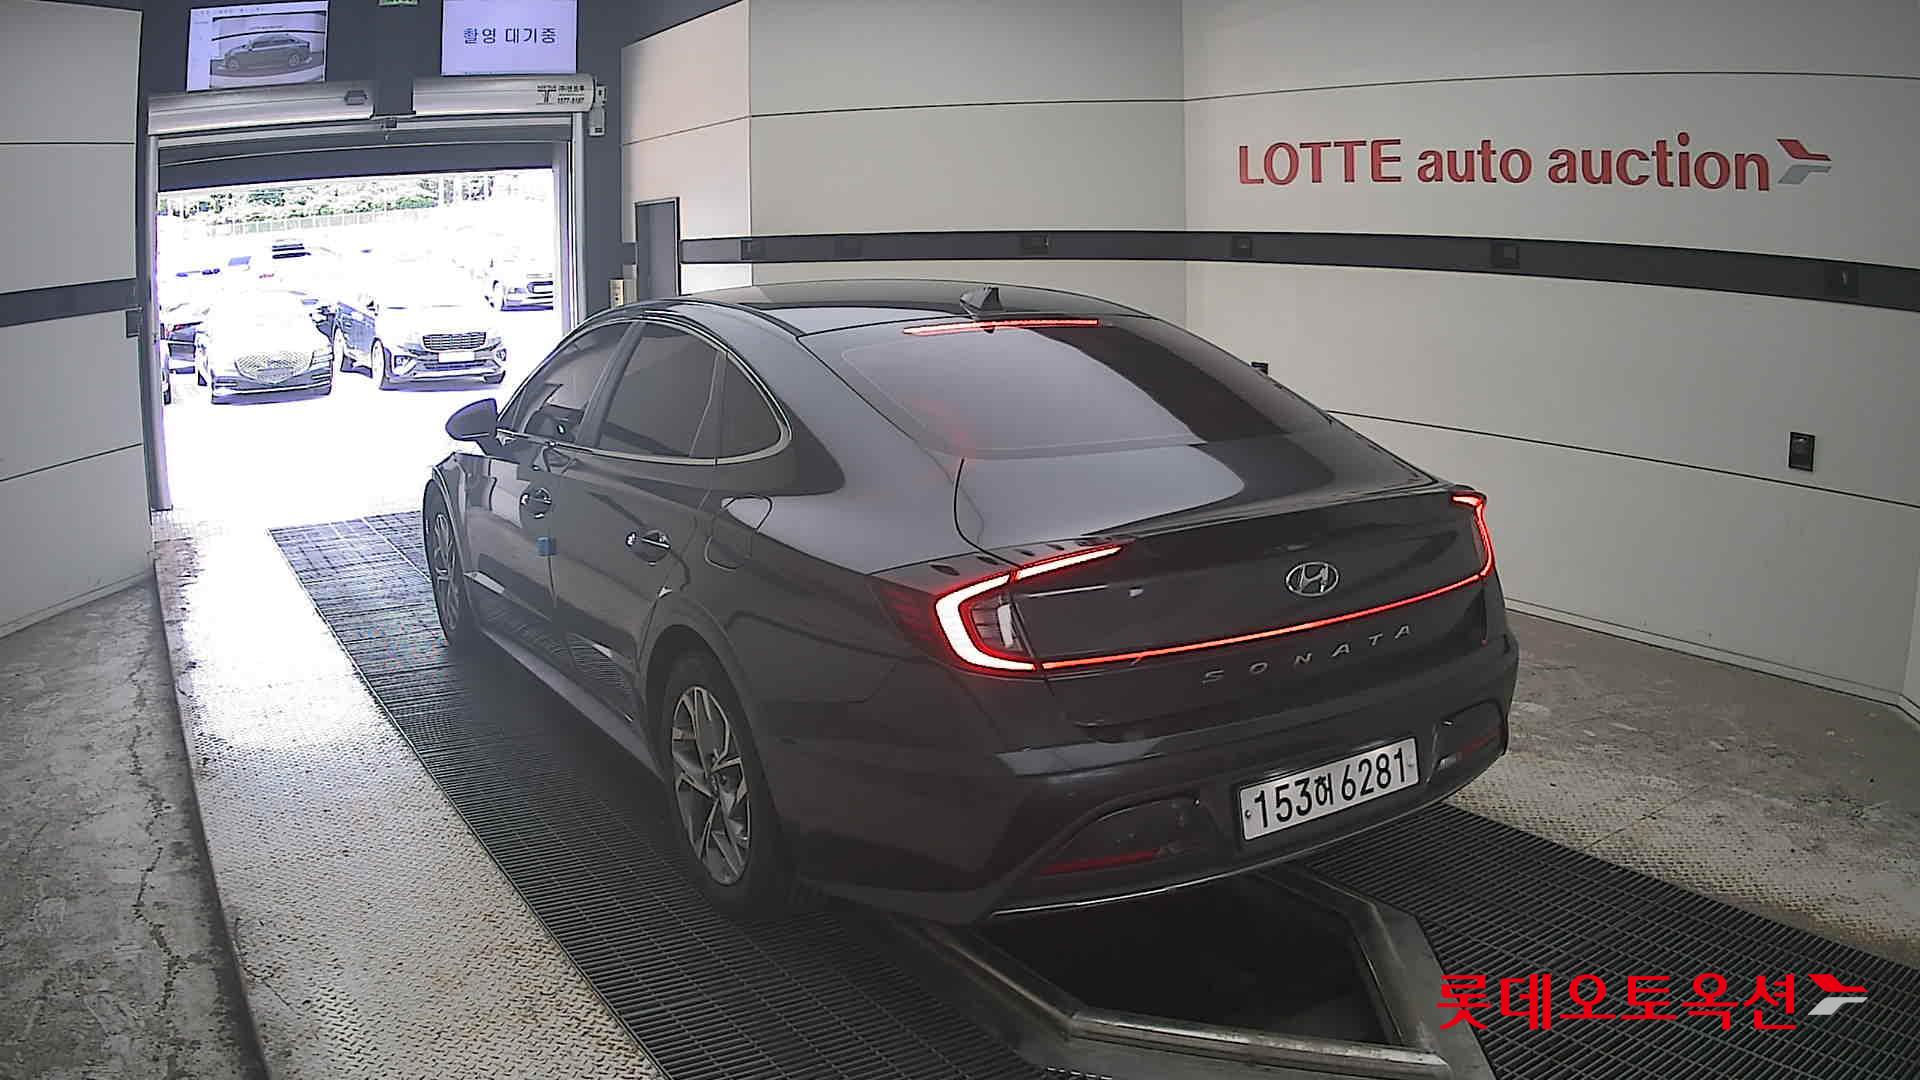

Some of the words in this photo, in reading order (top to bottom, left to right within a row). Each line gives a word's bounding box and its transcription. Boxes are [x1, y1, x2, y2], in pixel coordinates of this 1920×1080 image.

[464, 27, 496, 44] 촬영
[505, 27, 556, 44] 대기중
[1238, 139, 1402, 185] LOTTE
[1417, 140, 1532, 184] auto
[1548, 132, 1770, 191] auction
[1202, 624, 1410, 684] SONATA
